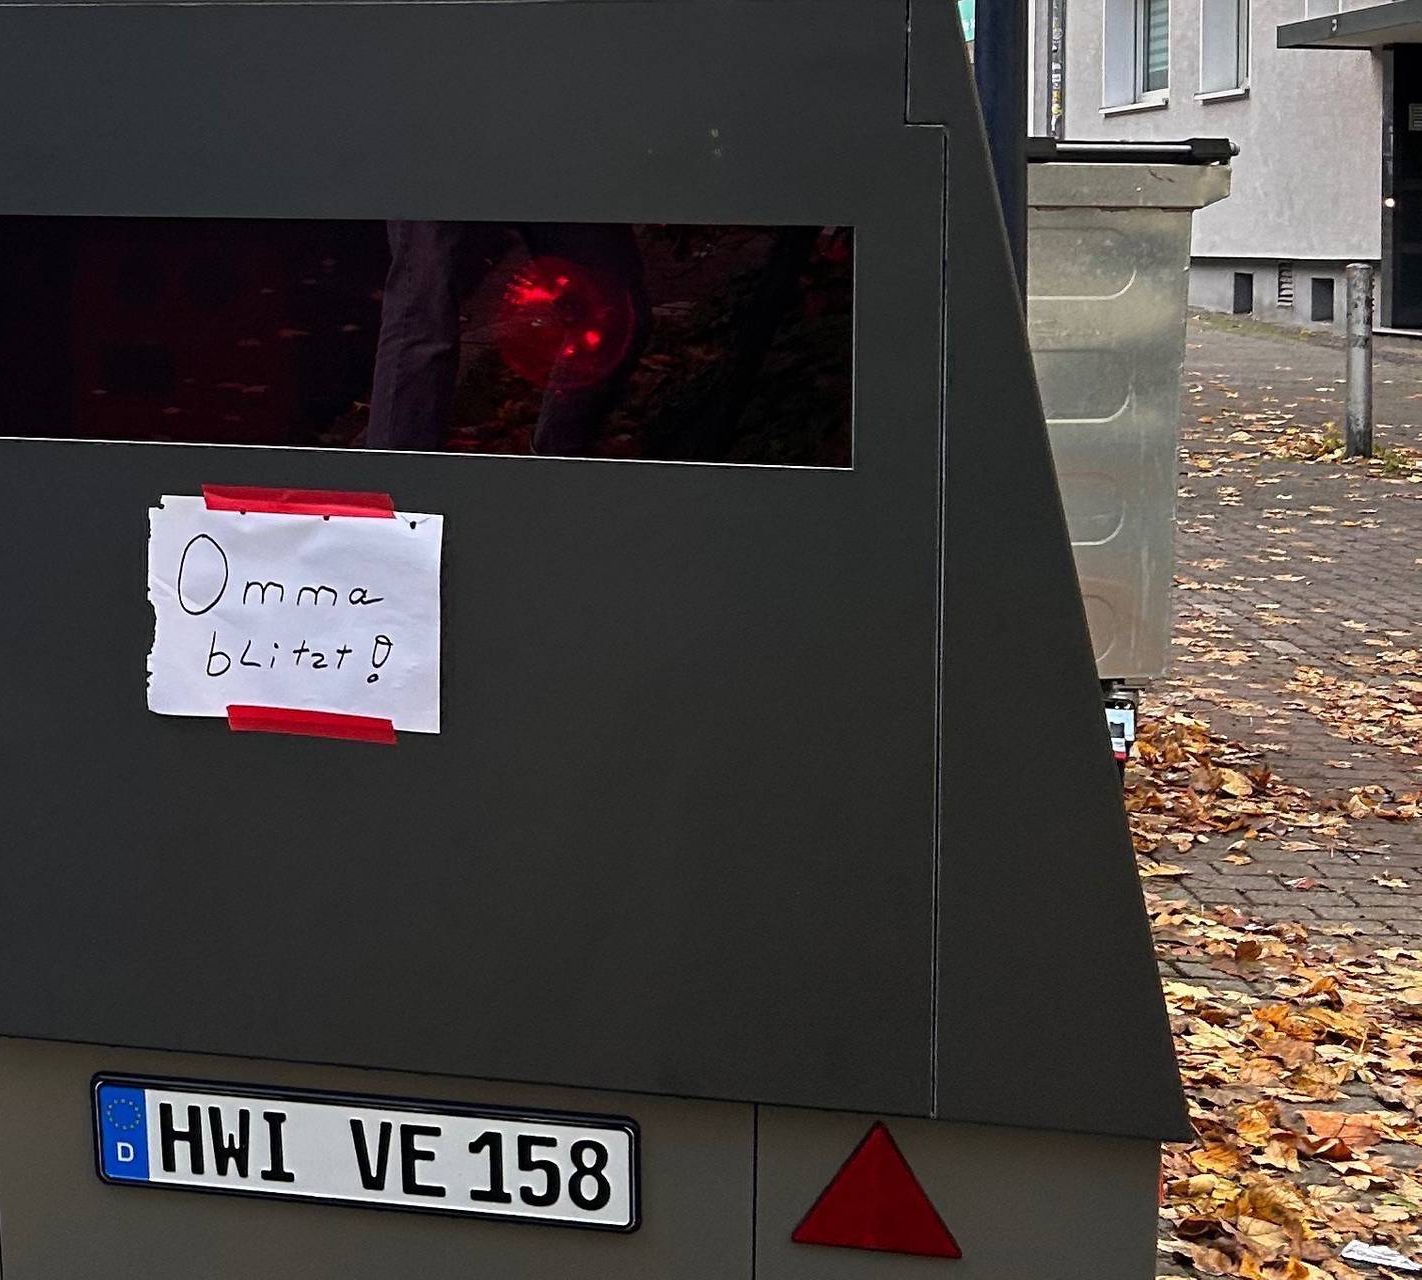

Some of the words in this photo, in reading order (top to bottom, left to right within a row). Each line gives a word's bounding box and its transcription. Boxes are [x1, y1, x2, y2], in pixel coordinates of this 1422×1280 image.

[177, 533, 385, 616] Omma
[116, 1141, 134, 1162] D
[159, 1102, 295, 1183] HWI
[349, 1118, 447, 1198] VE
[468, 1131, 612, 1211] 158
